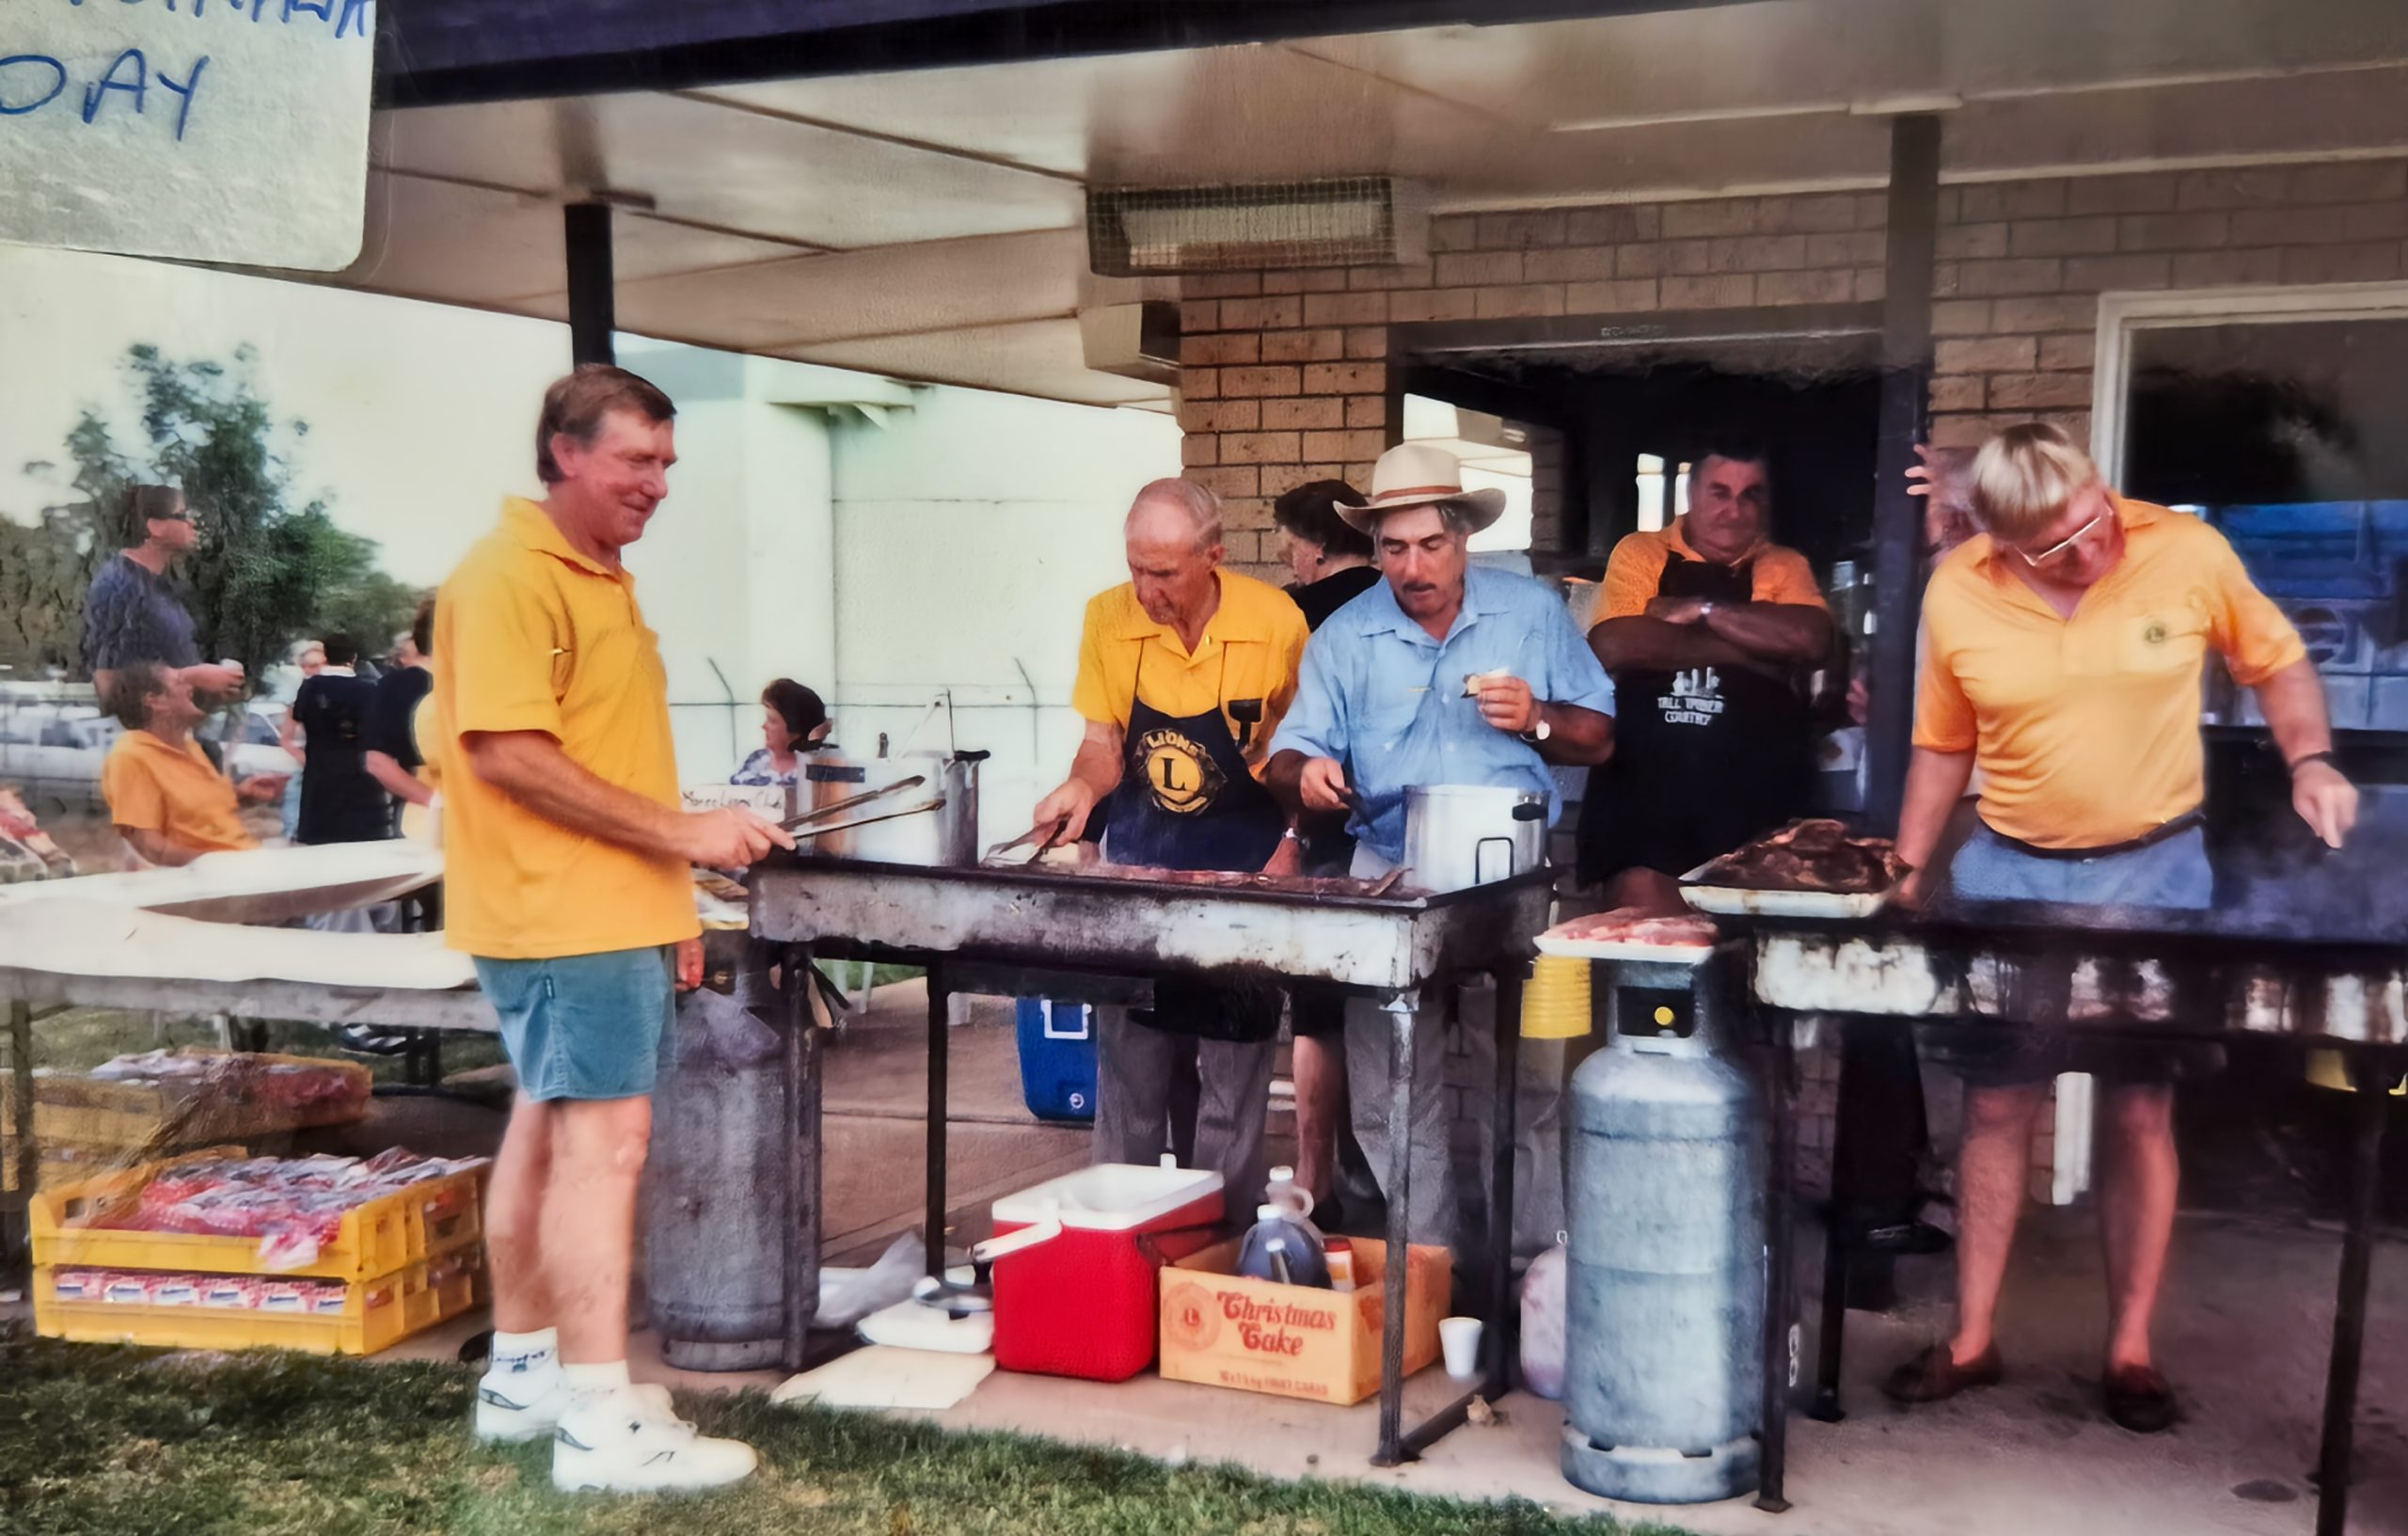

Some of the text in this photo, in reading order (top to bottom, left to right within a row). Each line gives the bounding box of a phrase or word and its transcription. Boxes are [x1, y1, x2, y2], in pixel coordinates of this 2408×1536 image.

[0, 48, 211, 141] DAY
[1147, 731, 1202, 756] LIONS
[1162, 757, 1186, 791] L
[1216, 1290, 1338, 1331] Christmas
[1238, 1321, 1305, 1356] Cake
